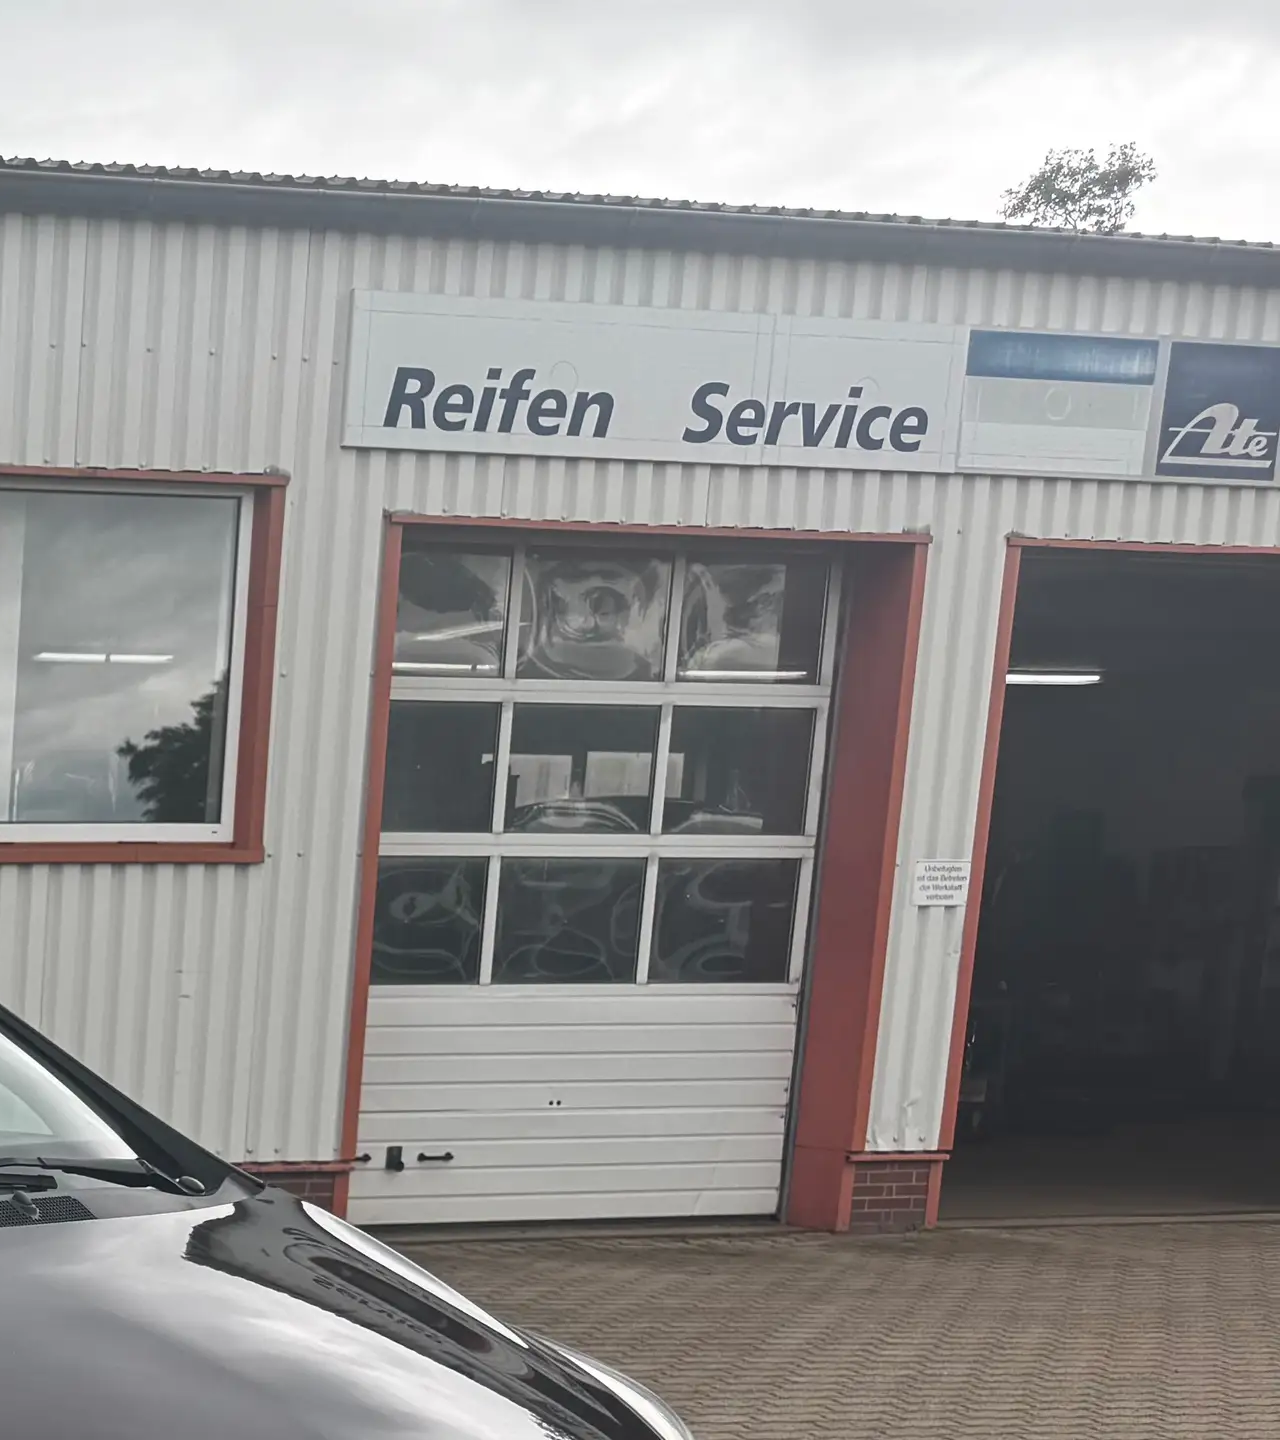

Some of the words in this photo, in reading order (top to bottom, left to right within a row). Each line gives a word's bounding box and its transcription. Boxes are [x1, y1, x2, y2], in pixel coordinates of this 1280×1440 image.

[382, 366, 615, 439] Reifen
[682, 381, 929, 453] Service
[1160, 402, 1277, 468] Ate
